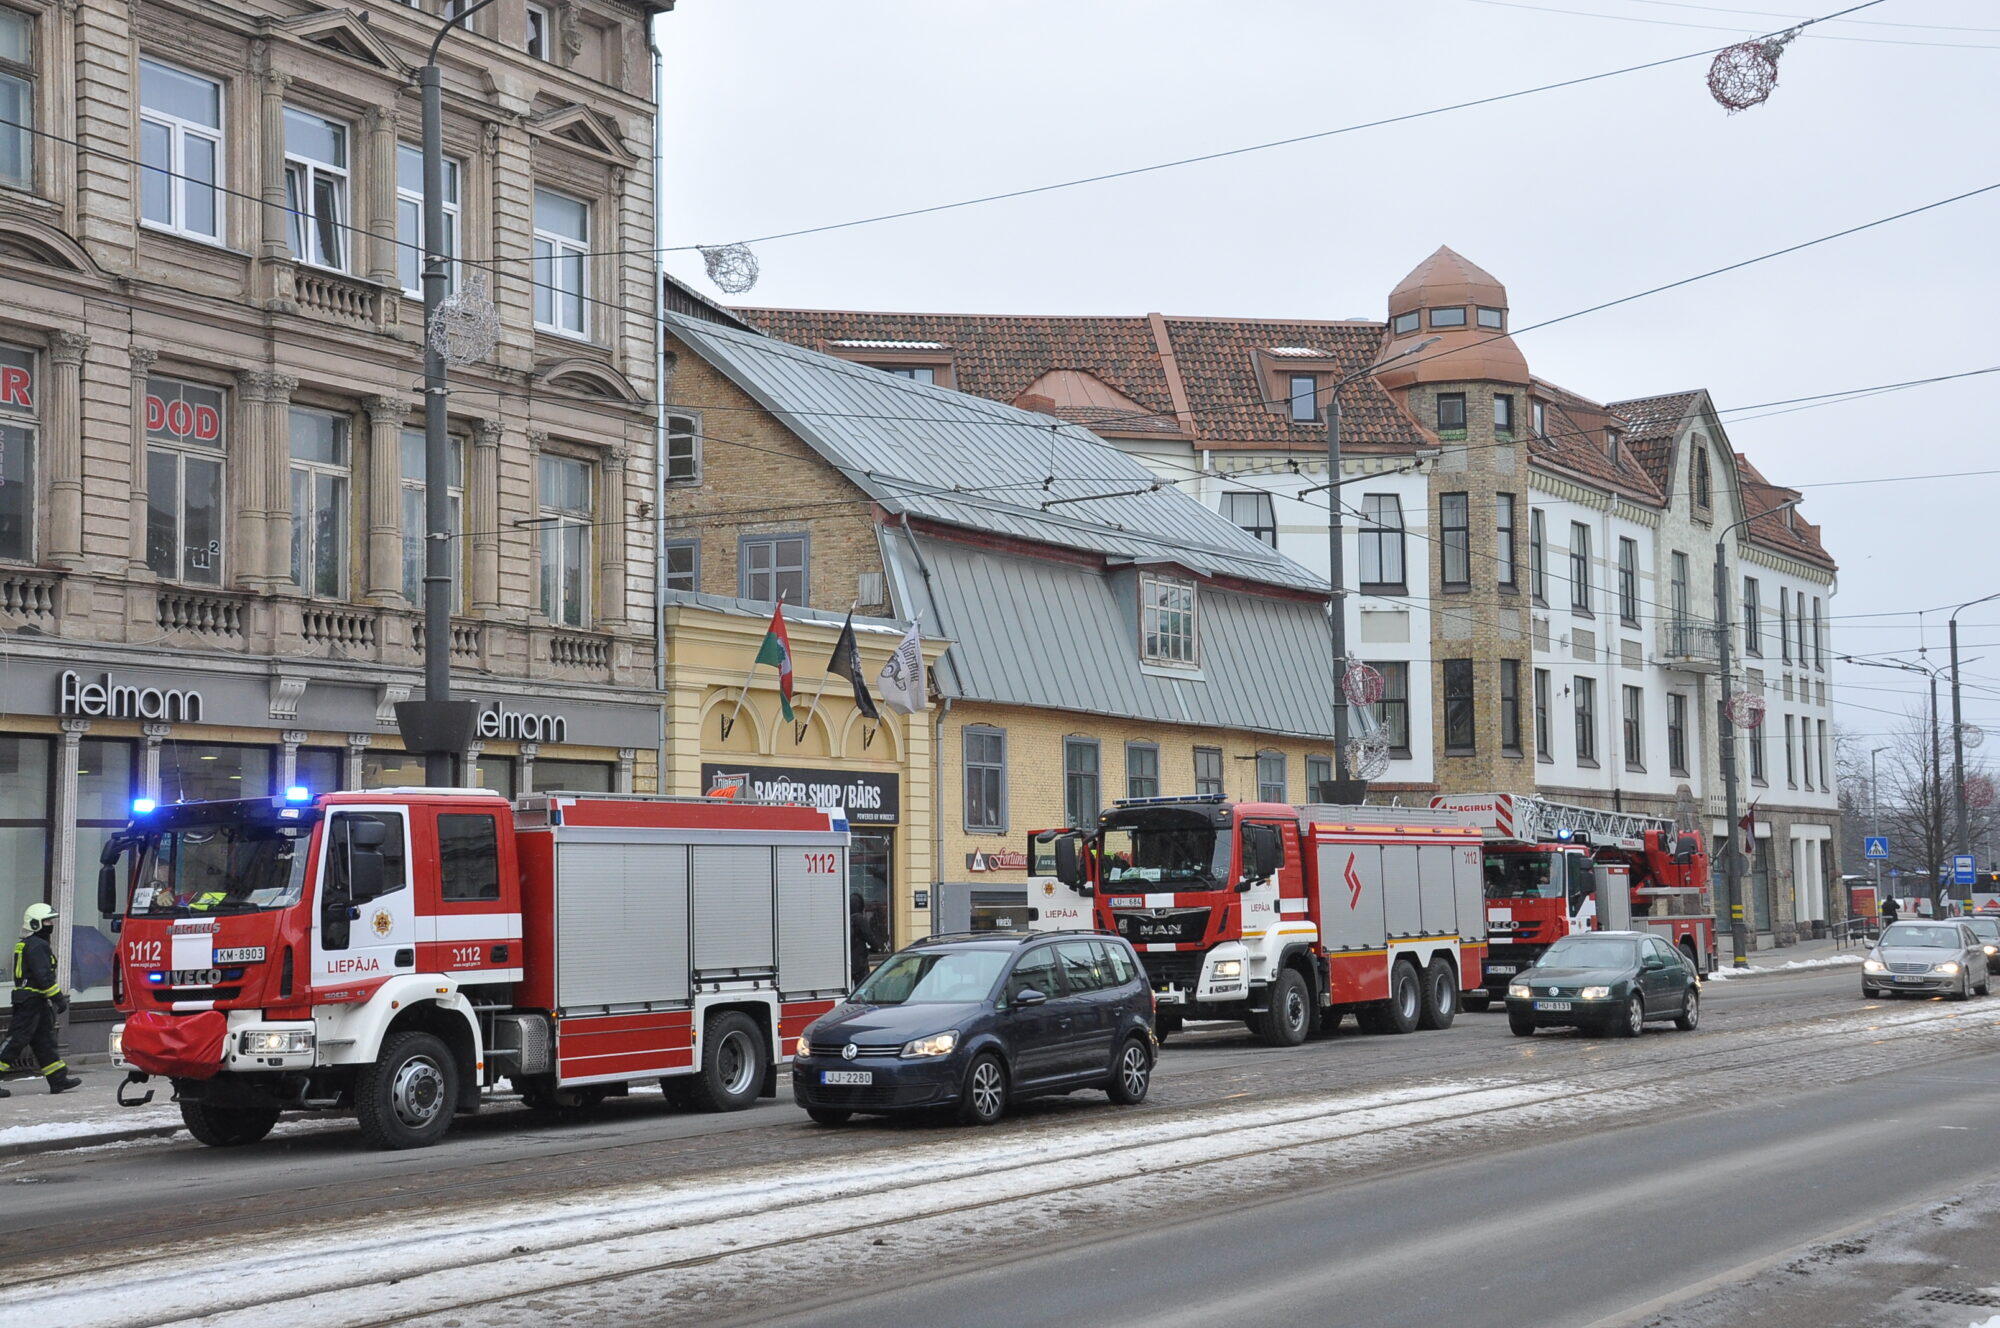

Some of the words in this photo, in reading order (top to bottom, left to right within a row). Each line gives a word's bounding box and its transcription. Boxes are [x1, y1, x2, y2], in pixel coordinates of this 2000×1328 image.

[61, 669, 204, 722] fielmann
[470, 699, 568, 742] ielmann
[1045, 908, 1079, 919] LIEPĀJA
[1250, 902, 1271, 913] LIEPĀJA
[166, 922, 221, 935] MAGIRUS
[1139, 923, 1182, 935] MAN
[1486, 920, 1520, 930] VECO
[134, 940, 162, 961] 112
[219, 948, 264, 961] KM-8903
[460, 946, 481, 962] 112
[327, 957, 380, 974] LIEPĀJA
[164, 968, 222, 985] IVECO
[827, 1072, 871, 1084] JJ-2280
